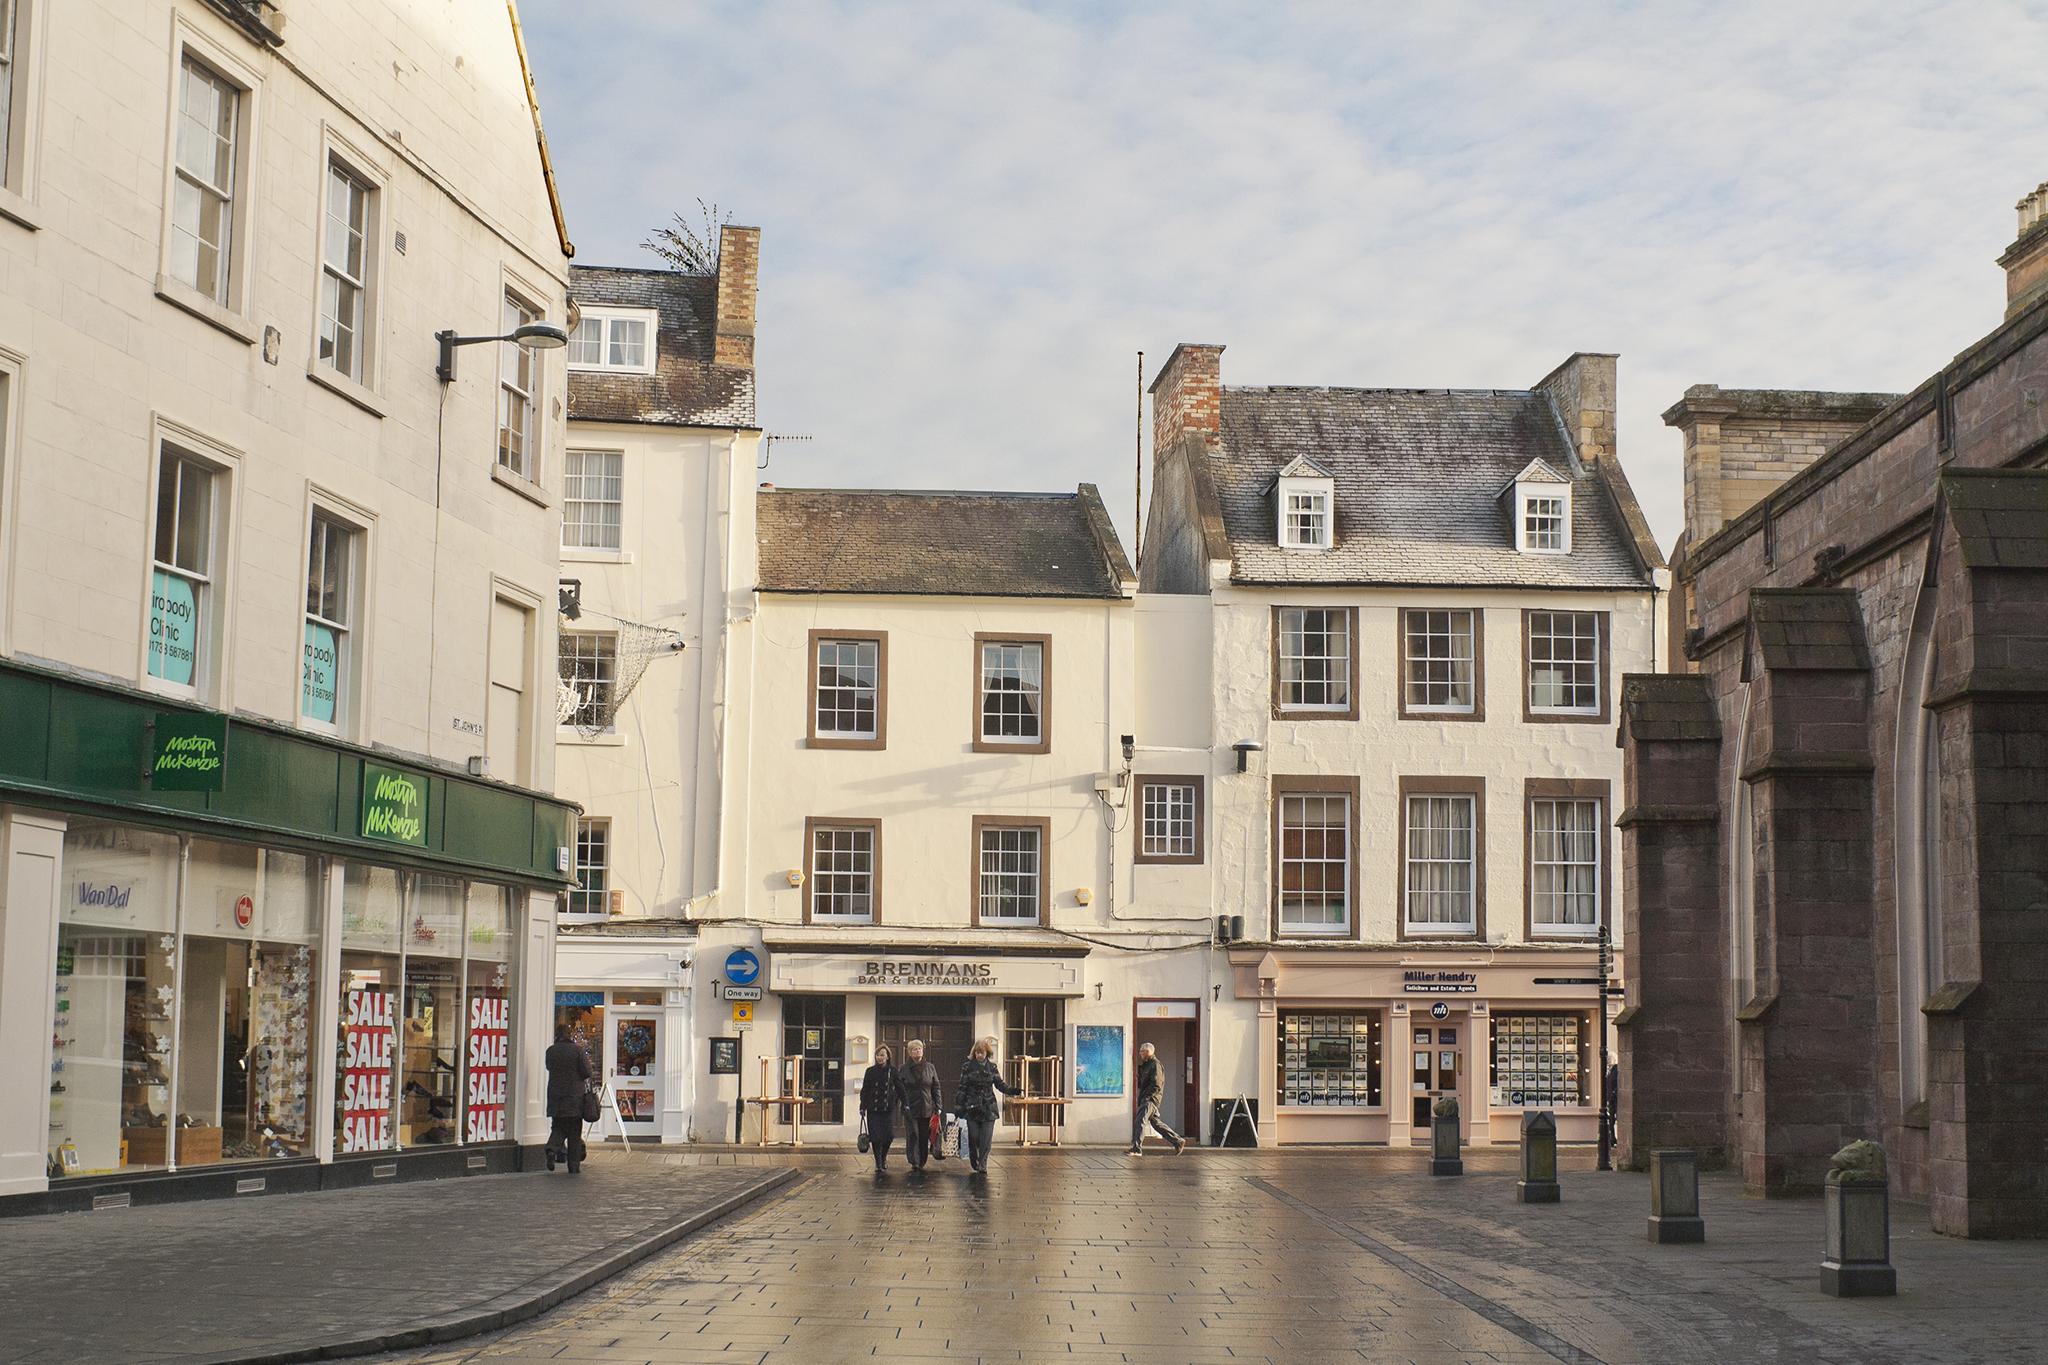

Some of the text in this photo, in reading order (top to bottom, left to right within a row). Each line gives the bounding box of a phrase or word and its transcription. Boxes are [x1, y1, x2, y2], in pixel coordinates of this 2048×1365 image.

[150, 617, 180, 642] Clinic
[169, 648, 193, 663] 587881
[156, 754, 221, 771] McKenzie
[165, 734, 216, 760] Mostyn
[374, 774, 417, 812] Mostyn
[365, 806, 421, 840] McKenzie
[858, 975, 998, 986] BAR & RESTAURANT
[866, 962, 991, 977] BRENNANS
[1405, 971, 1476, 983] Miller Hendry
[348, 991, 394, 1027] SALE
[727, 989, 741, 997] One
[471, 998, 509, 1030] SALE
[1156, 1006, 1168, 1017] 40
[346, 1031, 392, 1068] SALE
[469, 1034, 508, 1067] SALE
[344, 1074, 390, 1110] SALE
[469, 1072, 507, 1105] SALE
[343, 1116, 388, 1152] SALE
[467, 1110, 506, 1143] SALE
